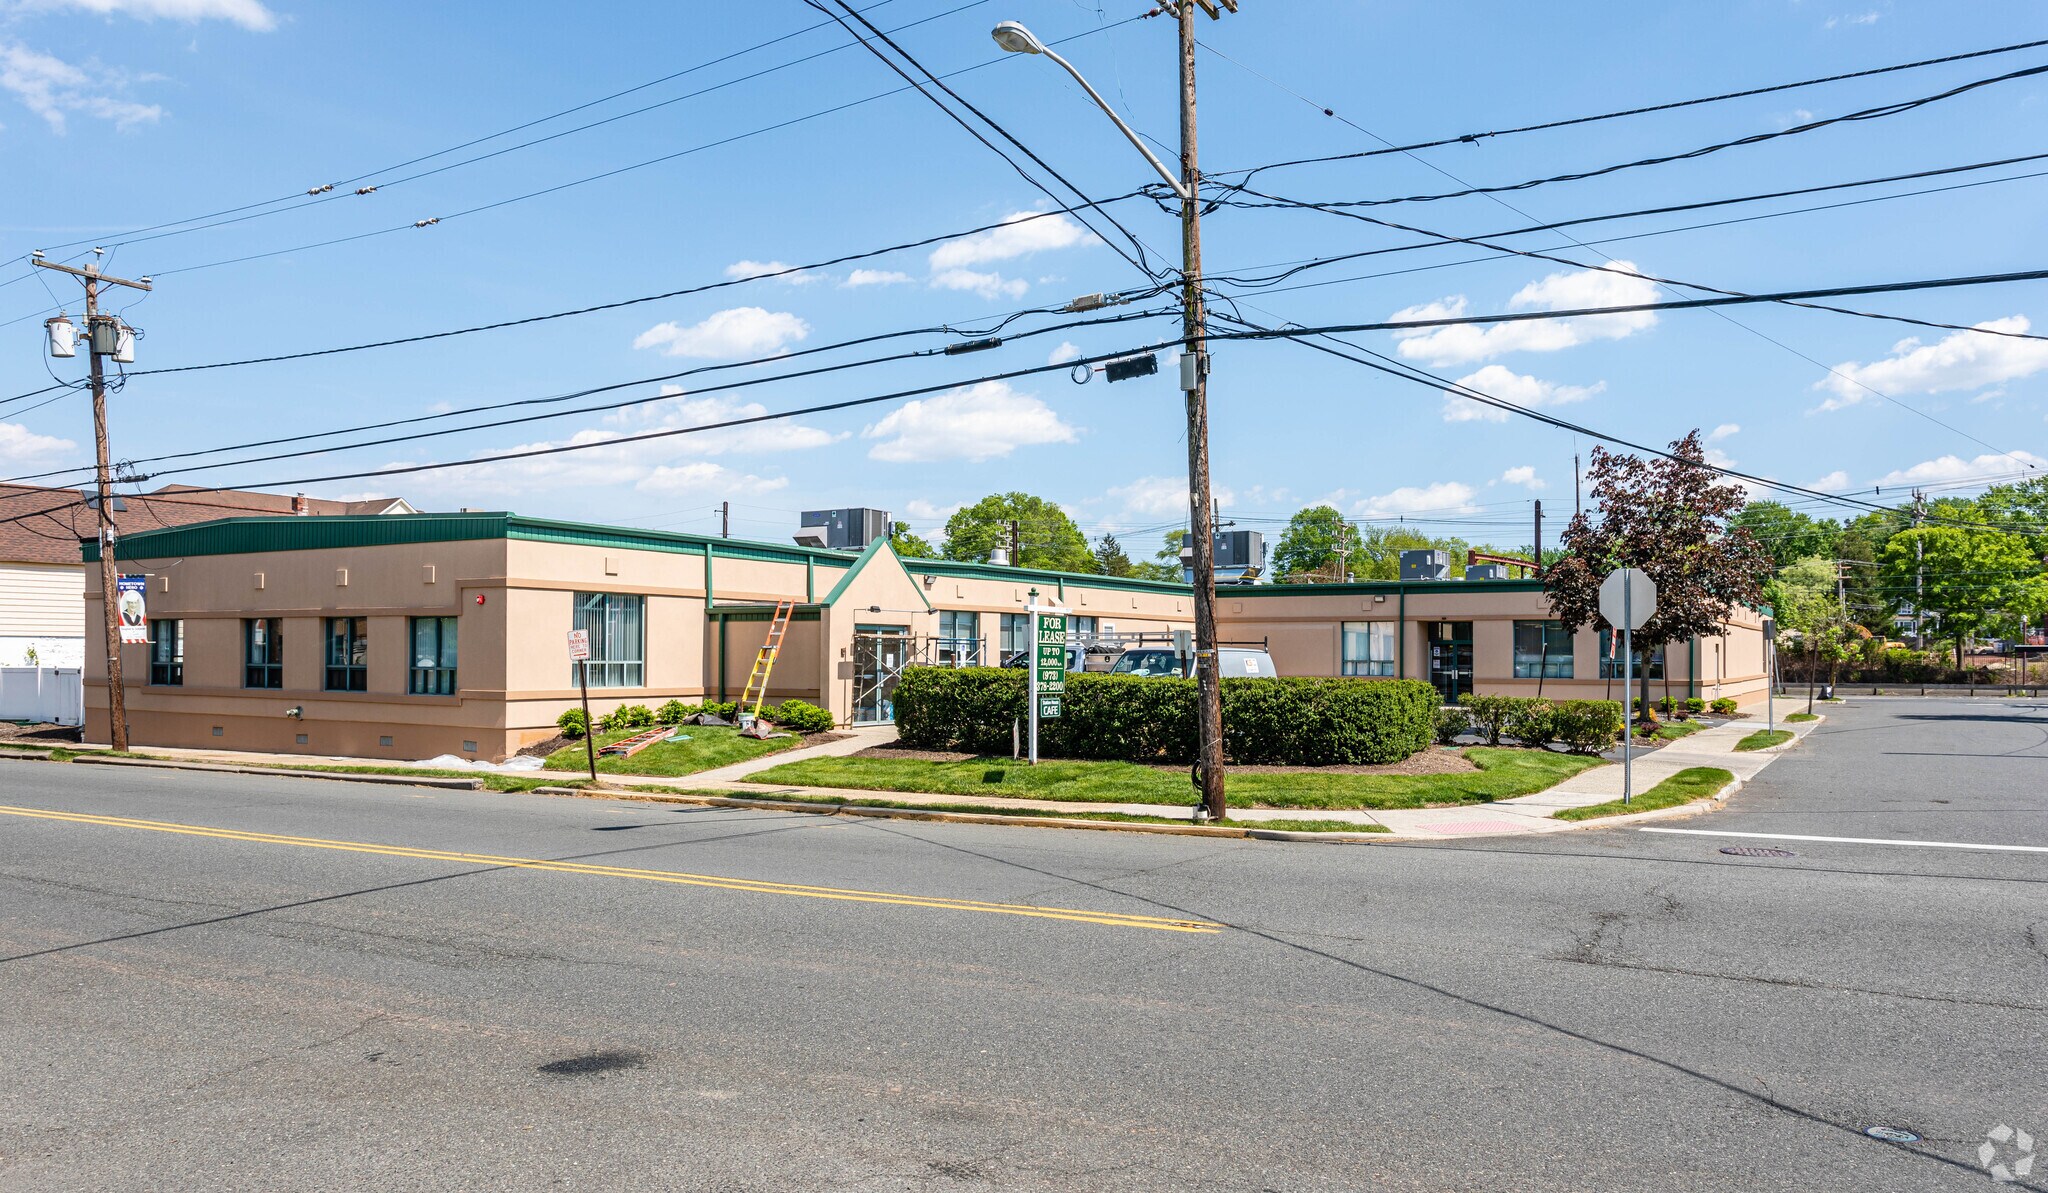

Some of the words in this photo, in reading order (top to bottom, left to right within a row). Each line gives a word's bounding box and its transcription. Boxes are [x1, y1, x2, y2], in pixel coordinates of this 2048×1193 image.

[1043, 617, 1062, 629] FOR
[569, 637, 587, 645] PARKING
[1038, 630, 1065, 644] LEASE
[1042, 647, 1051, 656] UP
[1051, 647, 1060, 656] TO
[1043, 705, 1058, 715] CAFE
